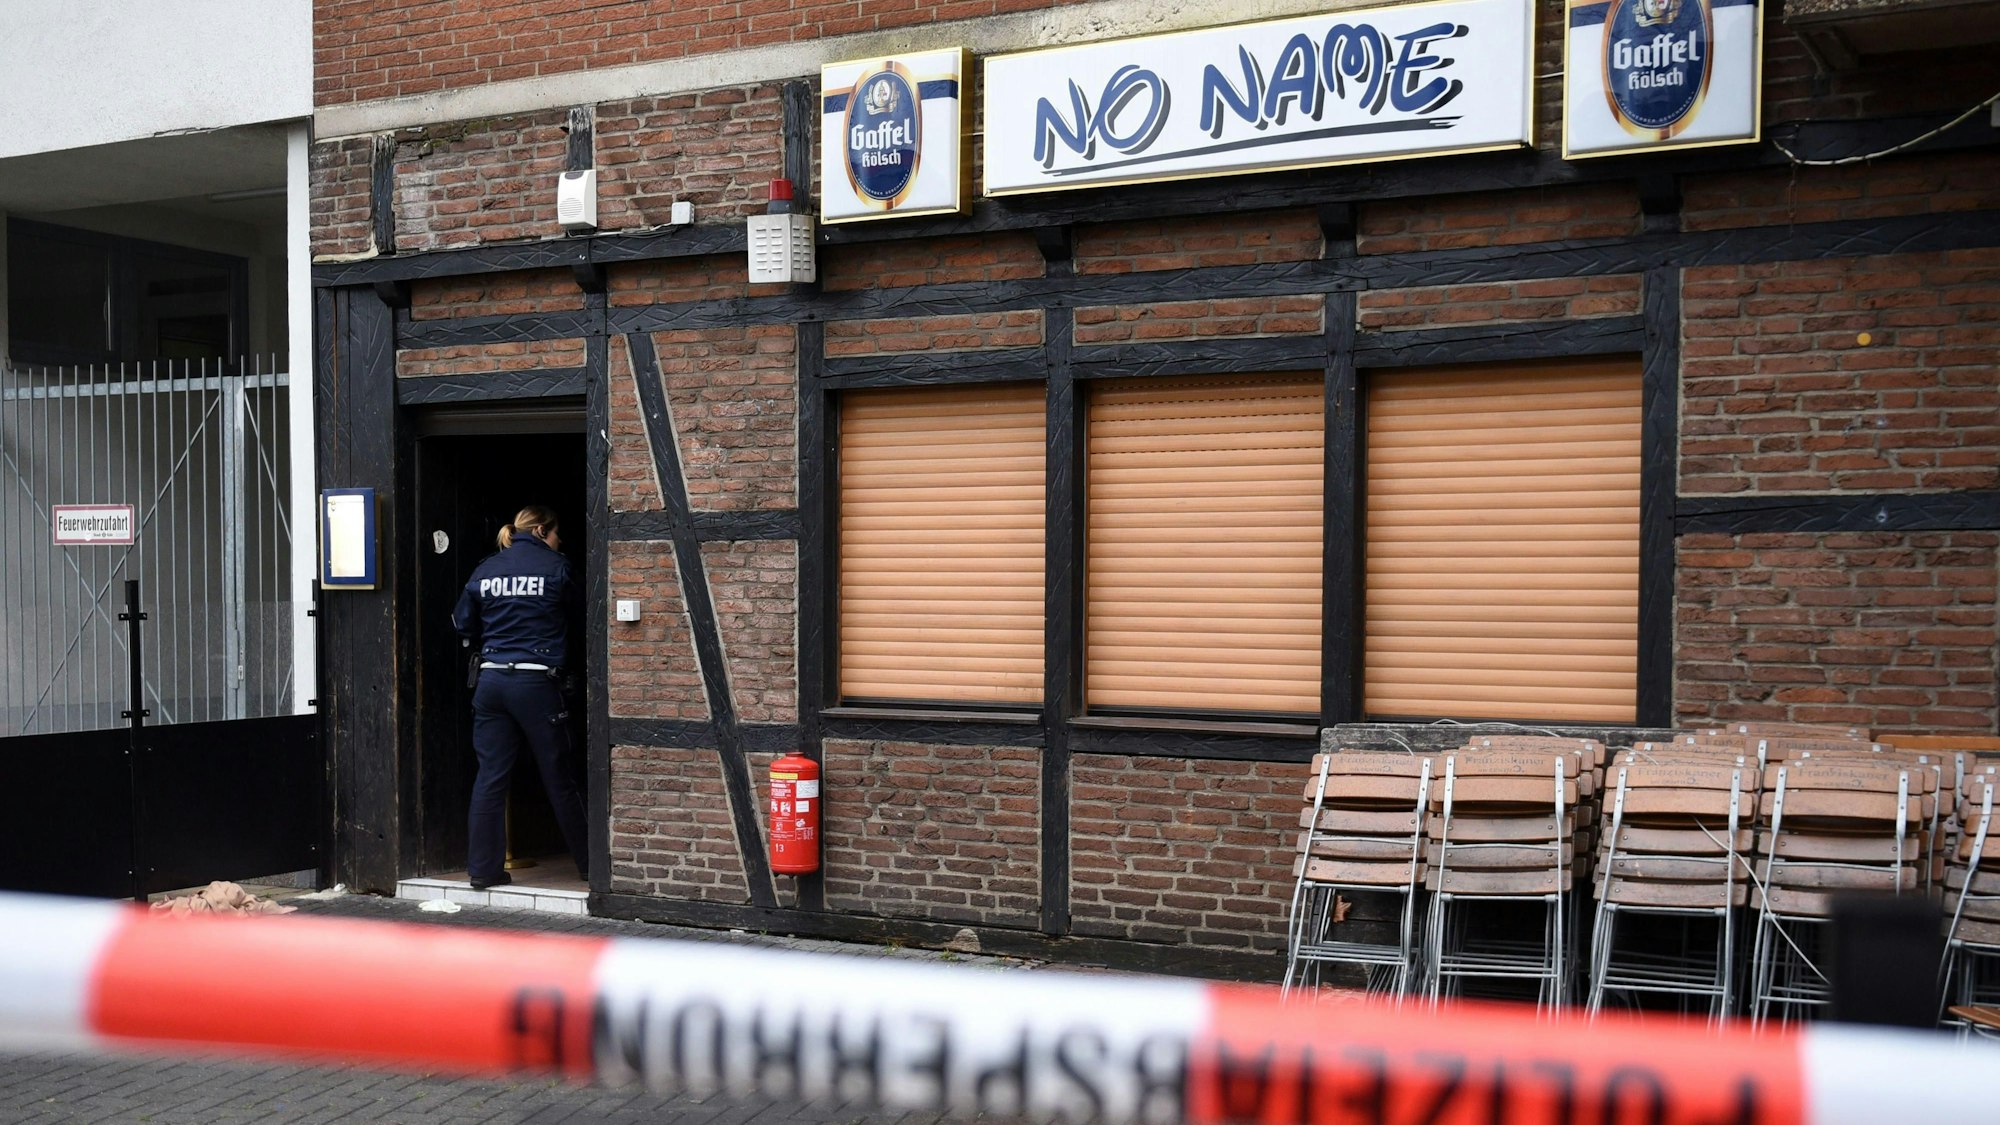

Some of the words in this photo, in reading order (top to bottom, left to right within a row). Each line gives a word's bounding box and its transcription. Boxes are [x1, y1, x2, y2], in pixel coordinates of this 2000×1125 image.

[1613, 30, 1701, 70] Gaffel
[1628, 68, 1684, 90] Kölsch
[1034, 64, 1171, 168] NO
[1199, 22, 1469, 139] NAME
[851, 118, 913, 150] Gaffel
[861, 150, 901, 168] Kölsch
[58, 516, 128, 531] Feuerwehrzufahrt
[480, 576, 545, 598] POLIZEI
[1638, 767, 1722, 778] Franziskaner
